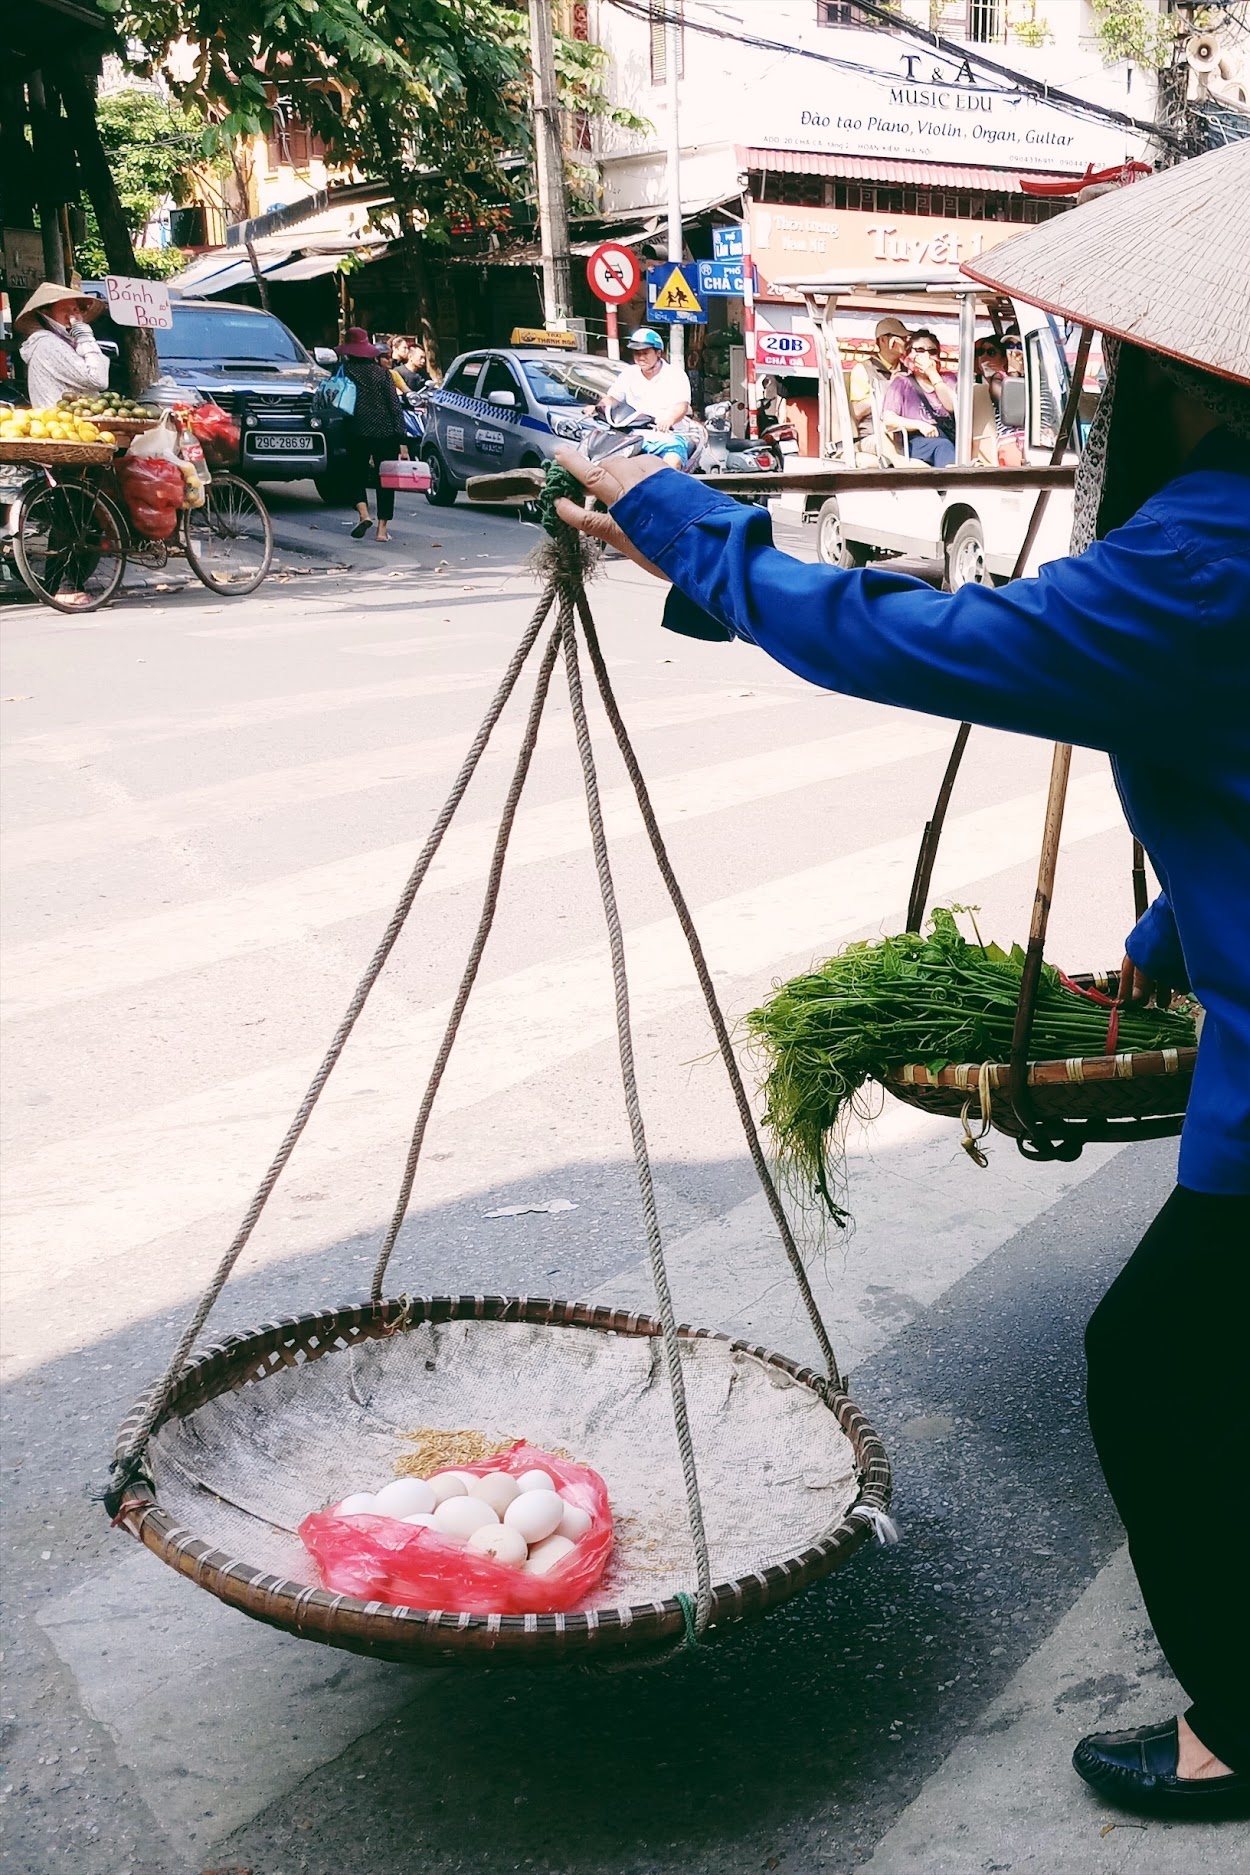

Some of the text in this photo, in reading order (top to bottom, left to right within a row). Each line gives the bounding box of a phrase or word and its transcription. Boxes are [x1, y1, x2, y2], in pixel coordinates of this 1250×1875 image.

[900, 54, 976, 83] T & A
[889, 88, 992, 113] MUSIC EDU
[801, 110, 831, 127] Đào
[837, 116, 862, 132] tạo
[868, 117, 914, 136] Piano,
[972, 124, 1020, 143] Organ,
[1025, 129, 1074, 147] Guitar
[865, 224, 962, 267] Tuyết
[704, 274, 732, 290] CHẢ
[724, 266, 742, 275] PHỐ
[107, 278, 154, 304] Bánh
[135, 305, 168, 327] Bao
[766, 337, 803, 351] 20B
[256, 437, 312, 449] 29C-286.97
